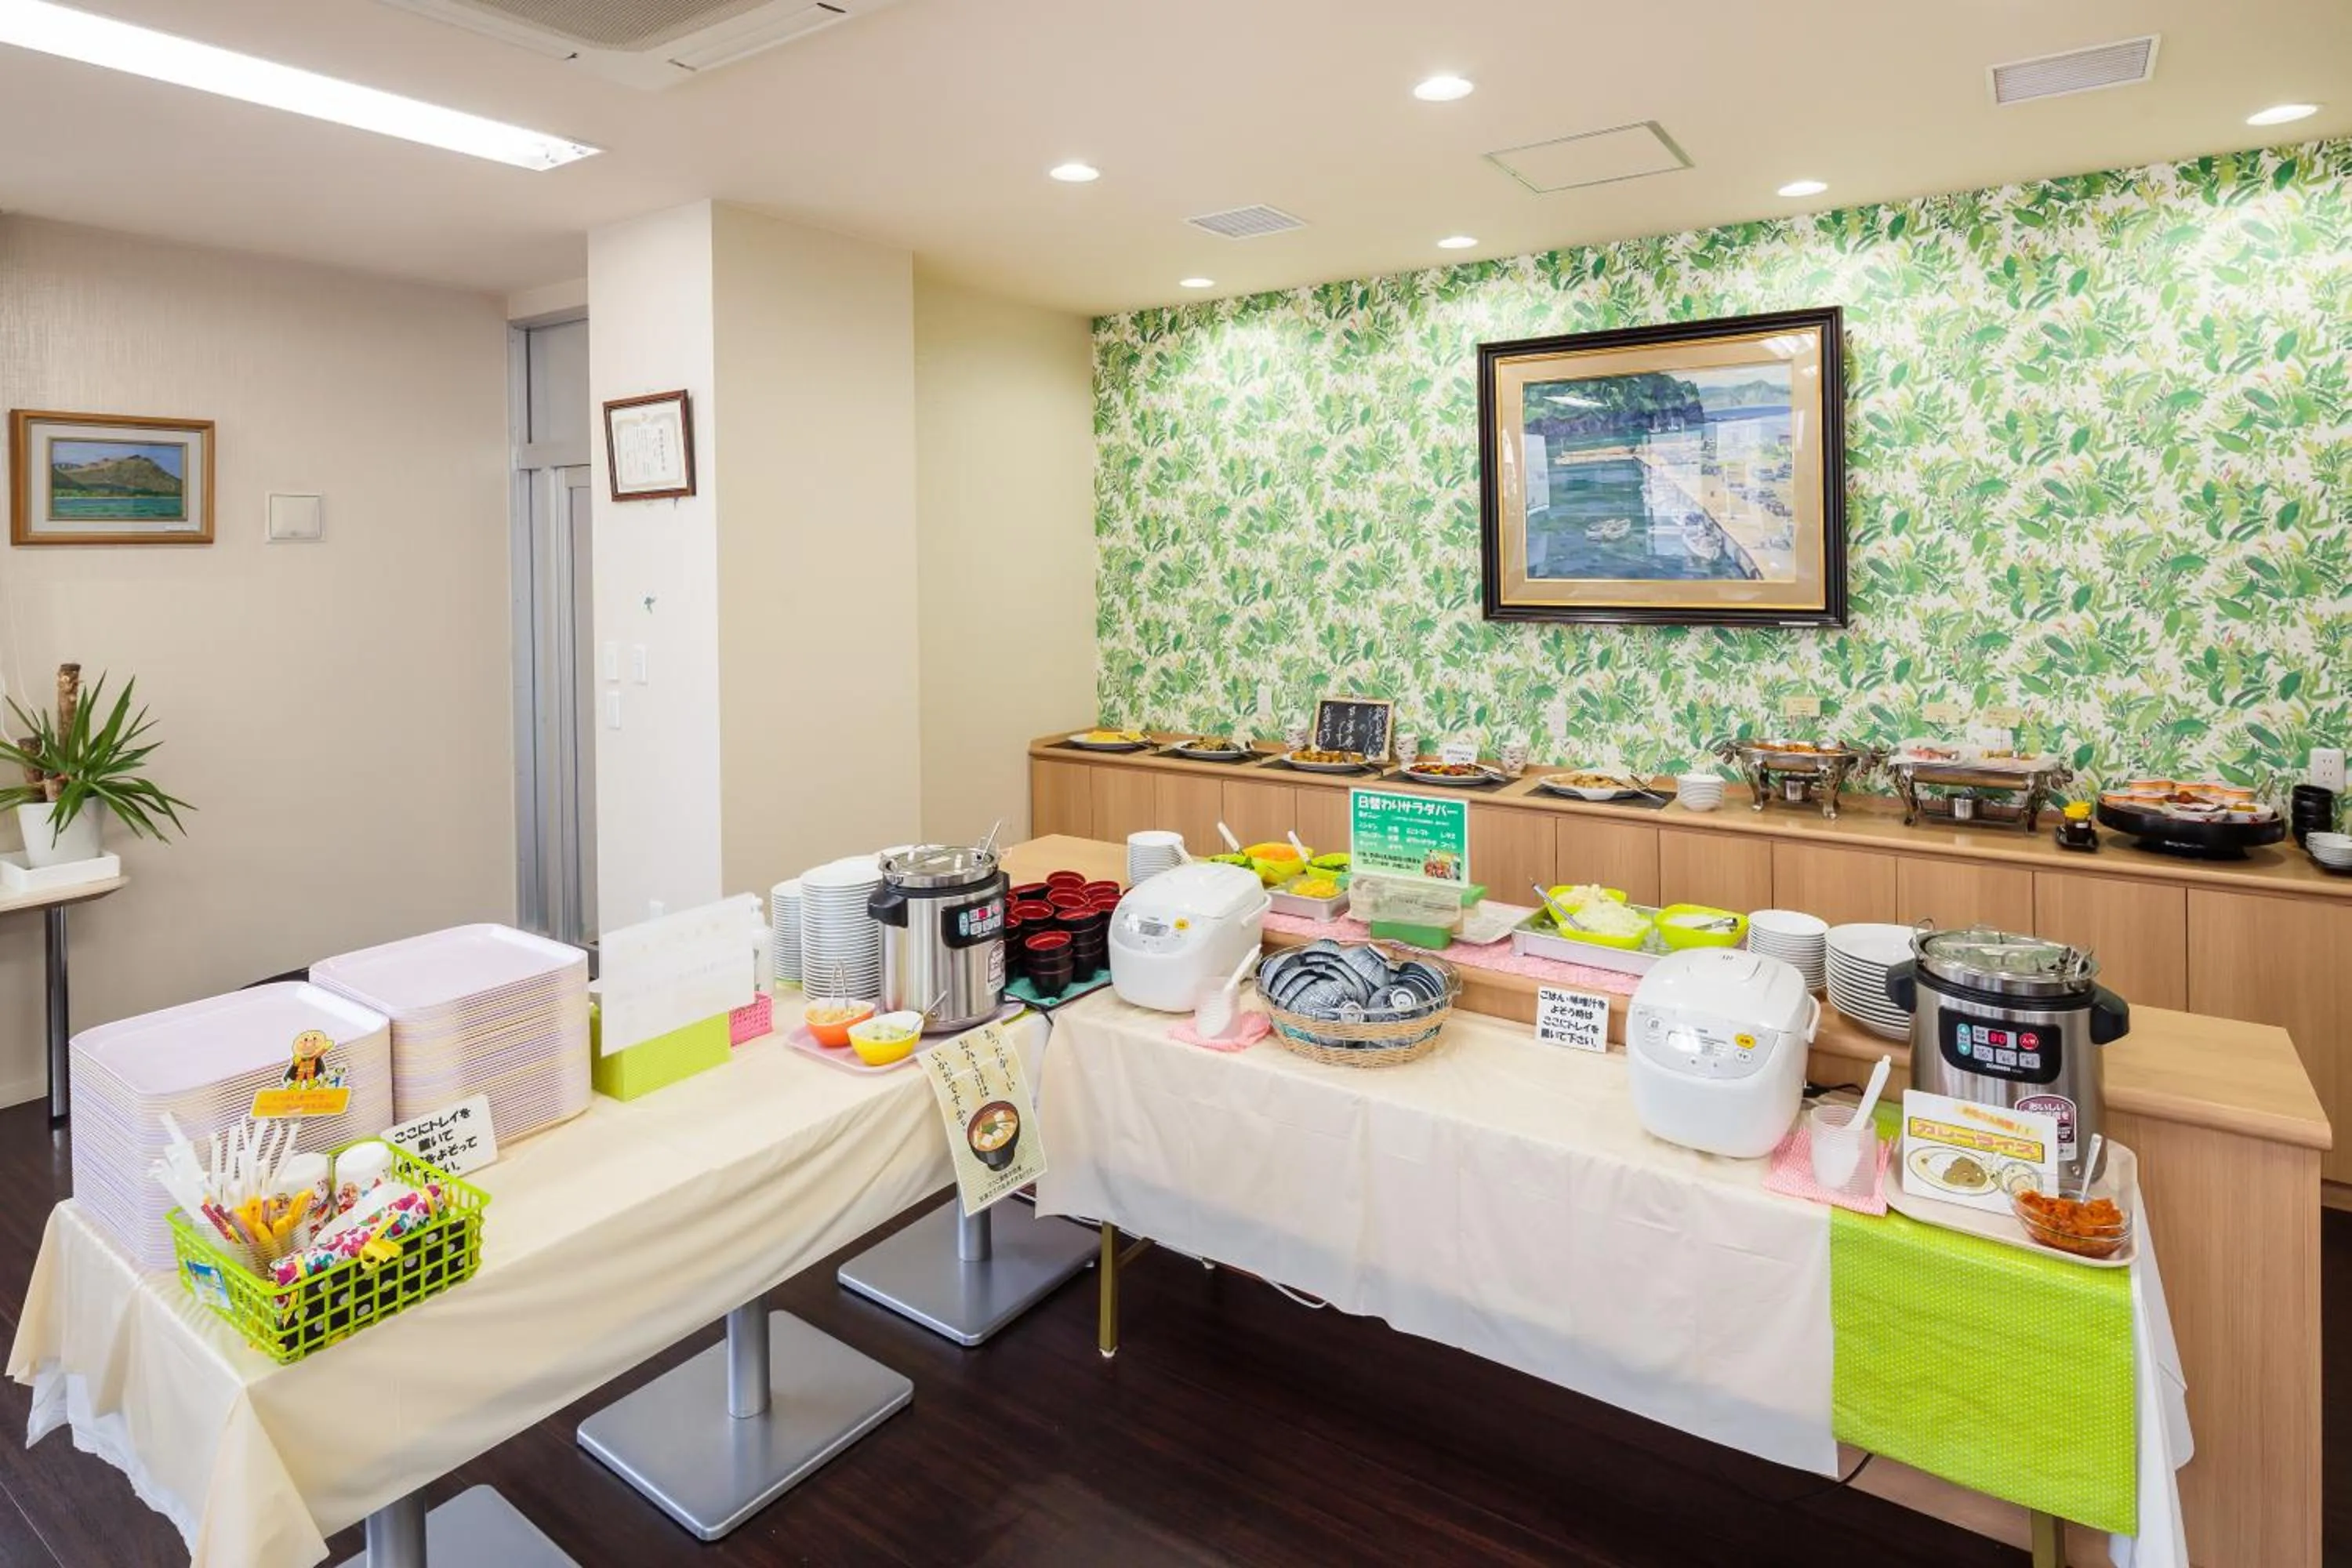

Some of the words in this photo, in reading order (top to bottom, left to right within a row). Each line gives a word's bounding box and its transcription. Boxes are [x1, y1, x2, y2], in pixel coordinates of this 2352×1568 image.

[1358, 795, 1458, 816] 日替わりサラダバー
[1551, 1005, 1593, 1020] よそう時は
[1543, 1016, 1599, 1034] ここにトレイを
[394, 1108, 471, 1144] ここにトレイを
